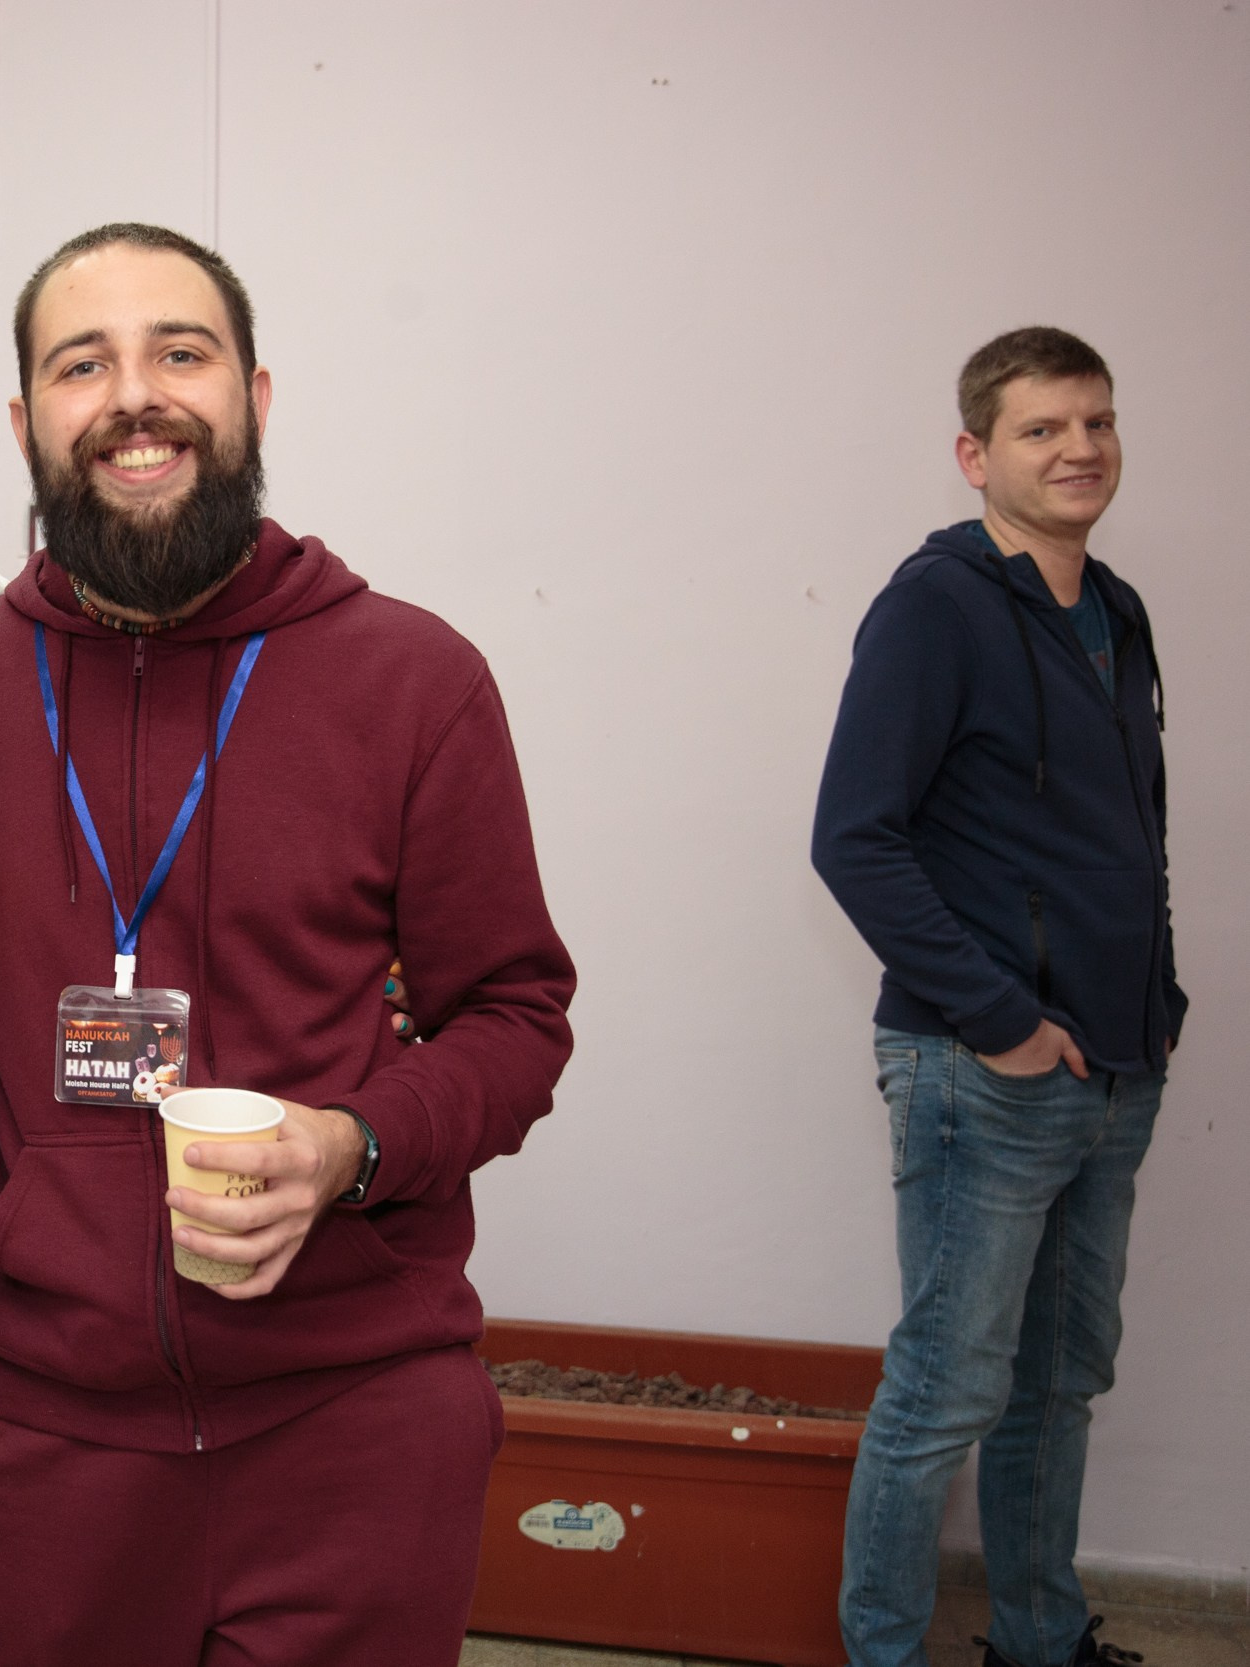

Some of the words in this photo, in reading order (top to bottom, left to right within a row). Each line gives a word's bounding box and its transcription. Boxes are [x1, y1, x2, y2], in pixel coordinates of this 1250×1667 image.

[65, 1029, 130, 1041] HANUKKAH
[65, 1041, 93, 1053] FEST
[65, 1080, 88, 1088] Moishe
[90, 1081, 110, 1089] House
[112, 1082, 130, 1090] Haifa
